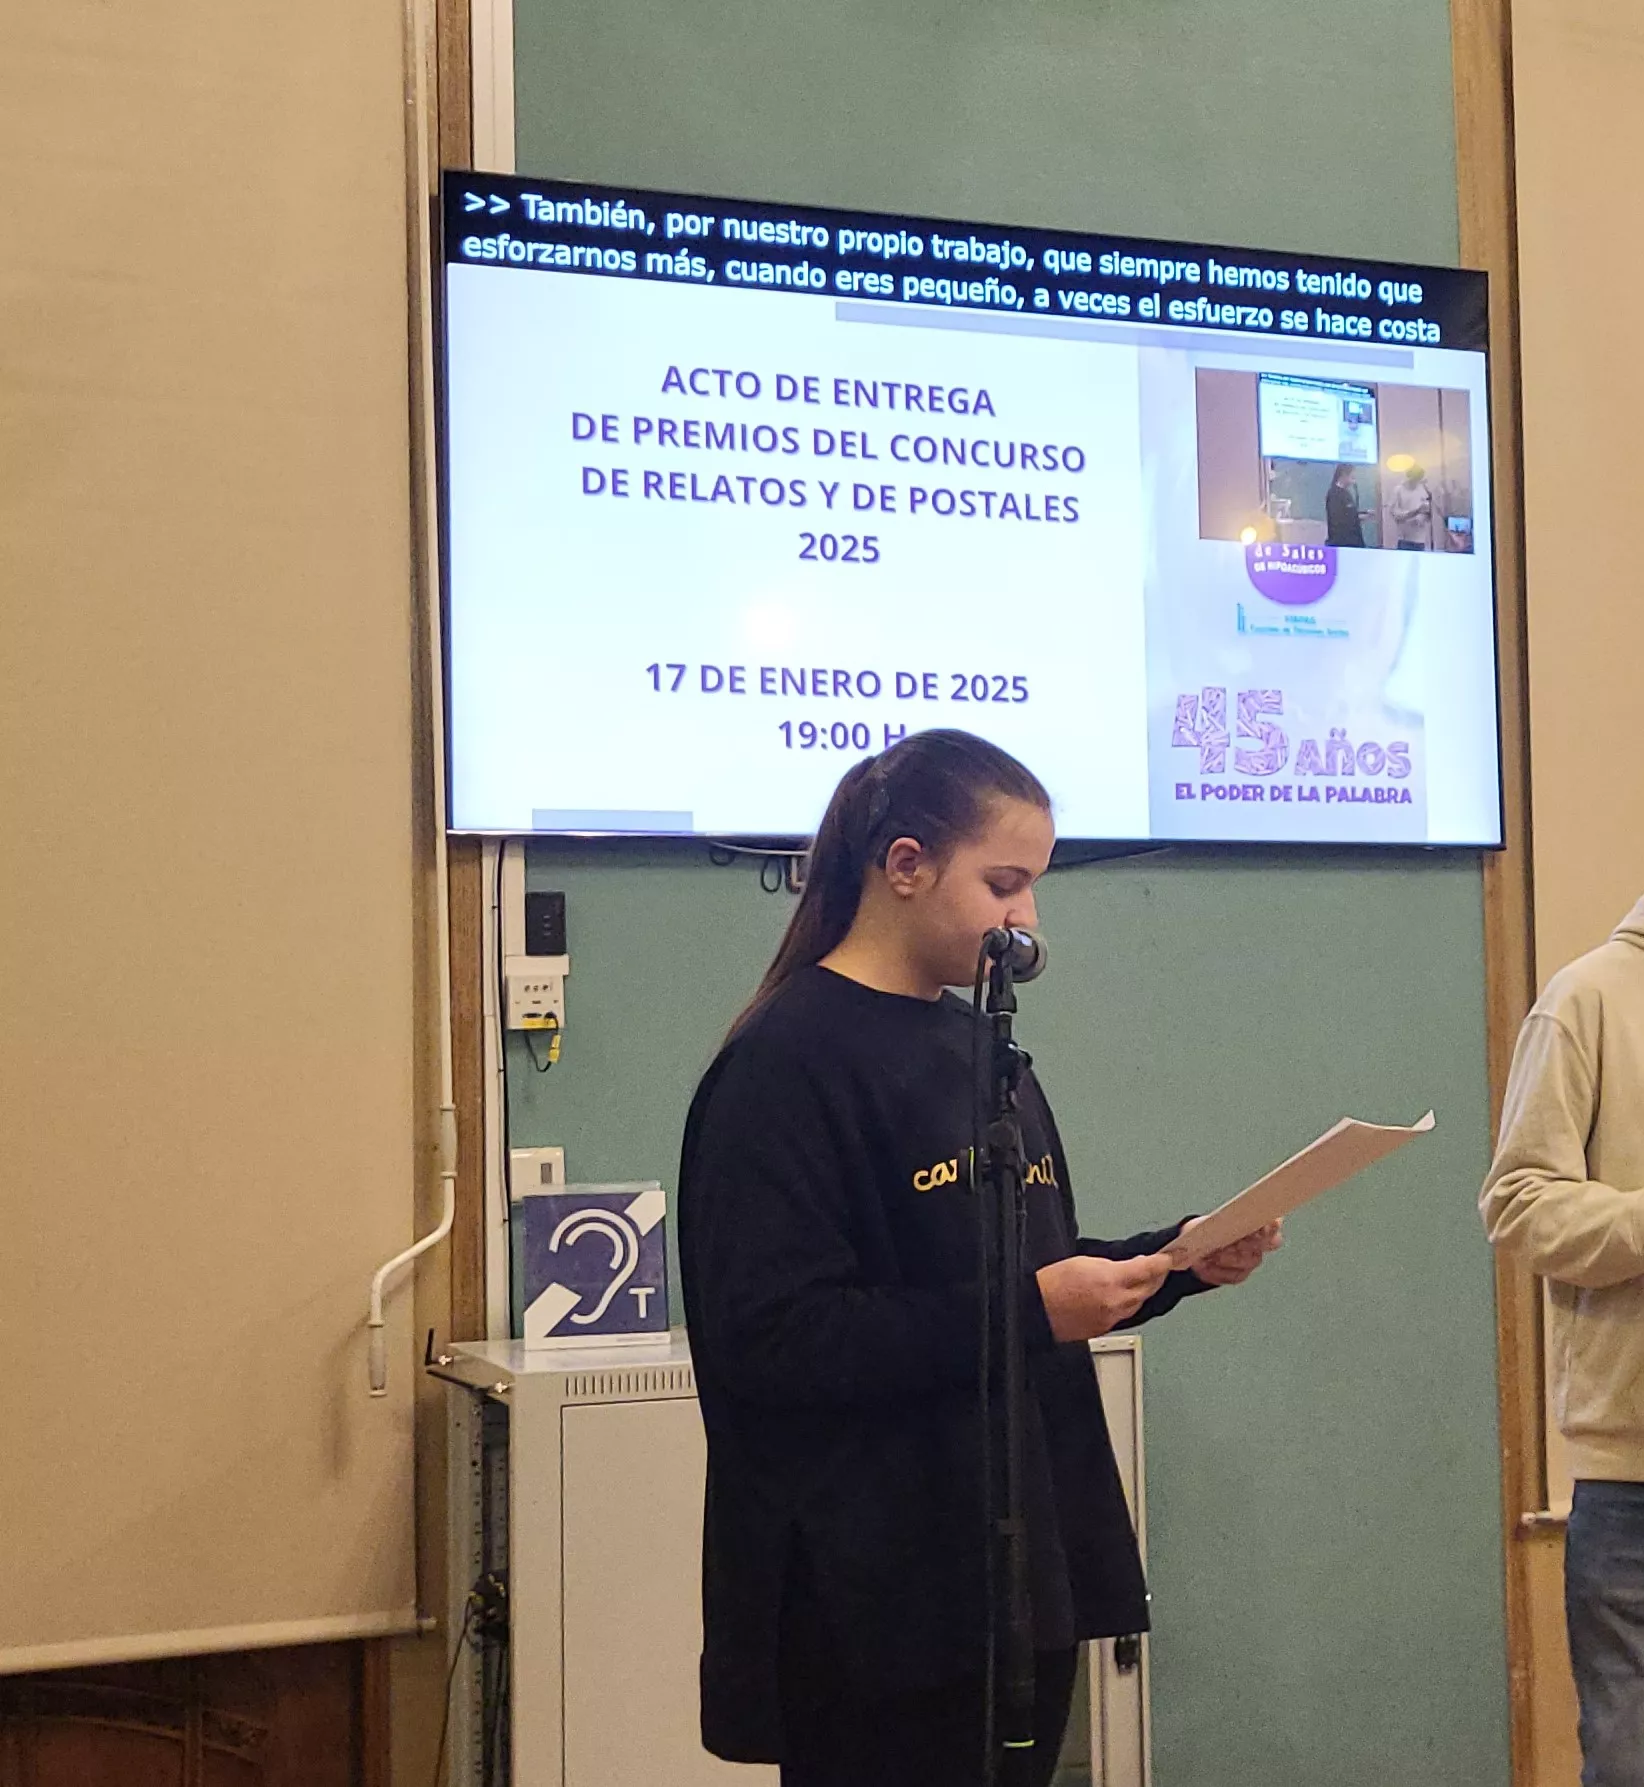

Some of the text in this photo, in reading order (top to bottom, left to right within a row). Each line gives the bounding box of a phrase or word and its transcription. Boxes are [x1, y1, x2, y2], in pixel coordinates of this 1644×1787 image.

[521, 193, 655, 234] También,
[665, 211, 715, 238] por
[723, 218, 829, 249] nuestro
[838, 230, 924, 260] propio
[932, 234, 1036, 271] trabajo,
[1043, 247, 1092, 276] que
[1100, 251, 1201, 285] siempre
[1208, 259, 1290, 292] hemos
[1296, 269, 1372, 300] tenido
[1378, 281, 1423, 307] que
[464, 233, 1442, 344] esforzarnos más, cuando eres pequeño, a veces el esfuerzo se hace costa
[661, 365, 997, 418] ACTO DE ENTREGA
[572, 412, 1086, 473] DE PREMIOS DEL CONCURSO
[581, 466, 1080, 523] DE RELATOS Y DE POSTALES
[798, 532, 881, 563] 2025
[645, 662, 1030, 702] 17 DE ENERO DE 2025
[777, 720, 870, 750] 19:00
[1172, 686, 1289, 777] 45
[1175, 783, 1413, 804] EL PODER DE LA PALABRA
[629, 1287, 656, 1319] T
